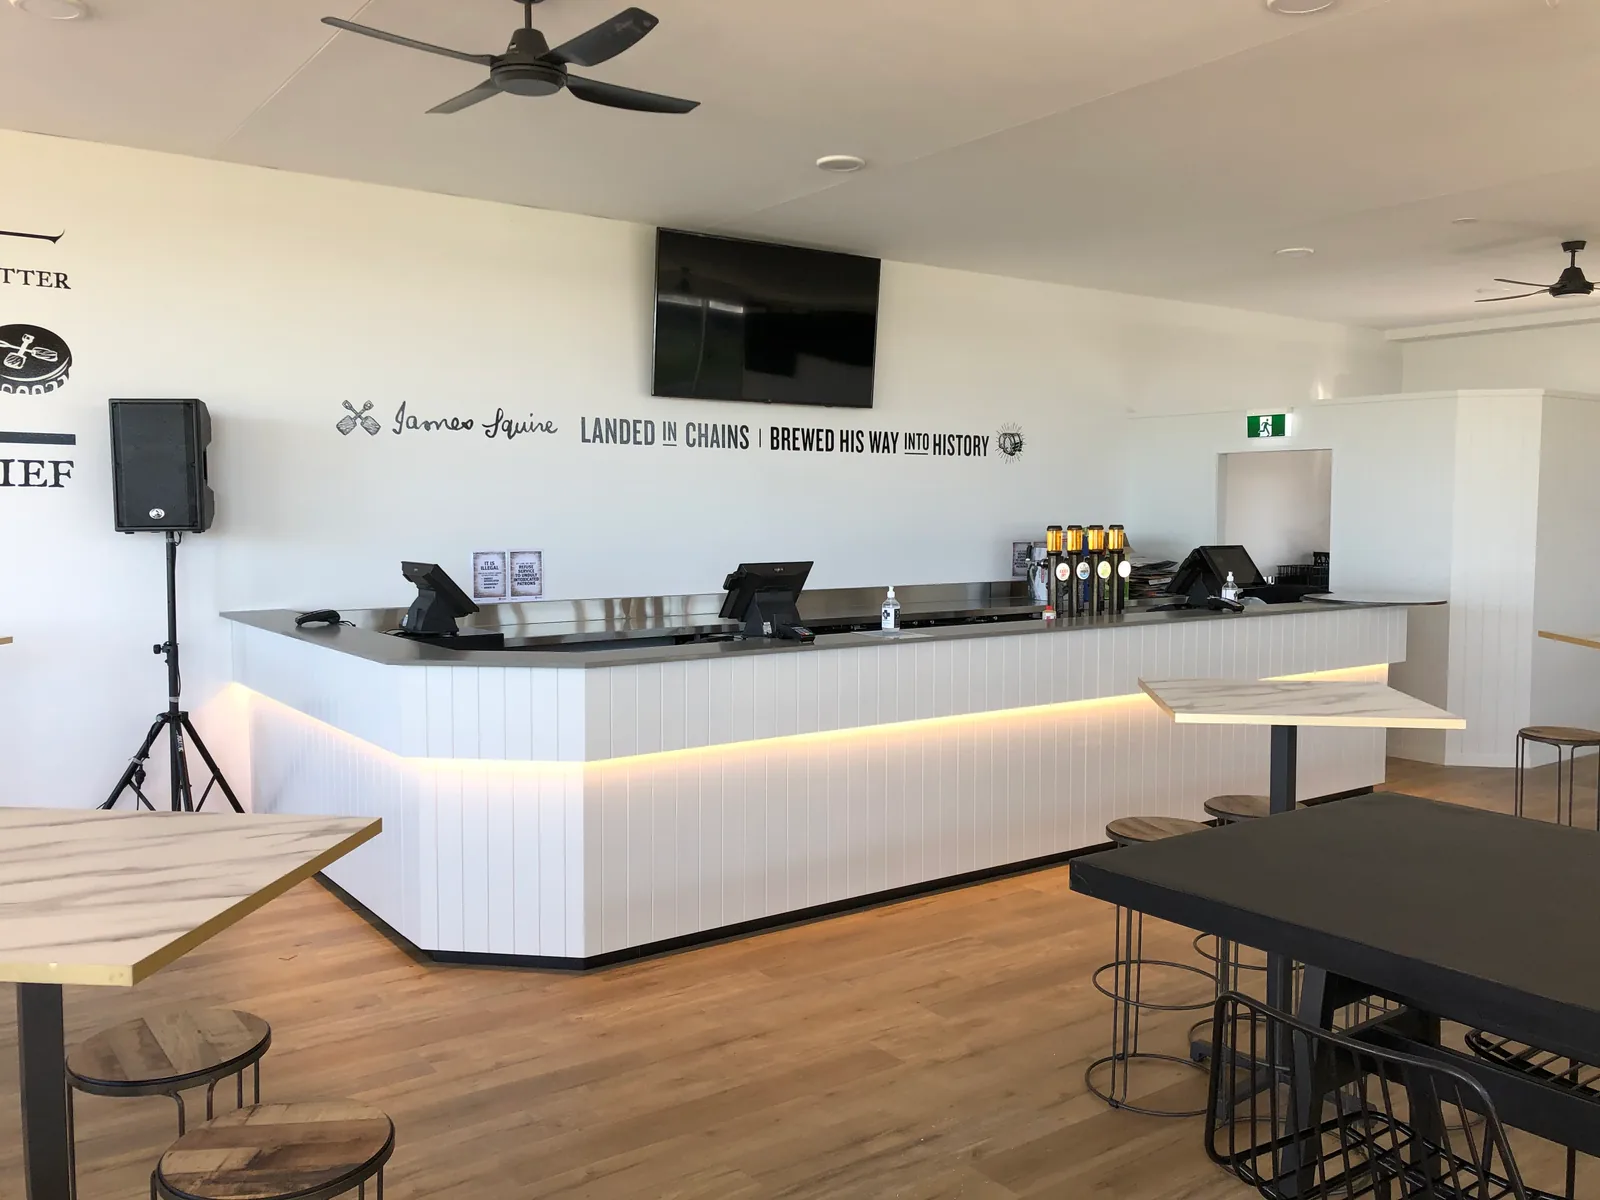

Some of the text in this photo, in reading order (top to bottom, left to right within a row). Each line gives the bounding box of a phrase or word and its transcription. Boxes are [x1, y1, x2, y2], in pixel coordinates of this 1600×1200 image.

[392, 400, 990, 457] James Squire LANDED IN CHAINS BREWED HIS WAY INTO HISTORY
